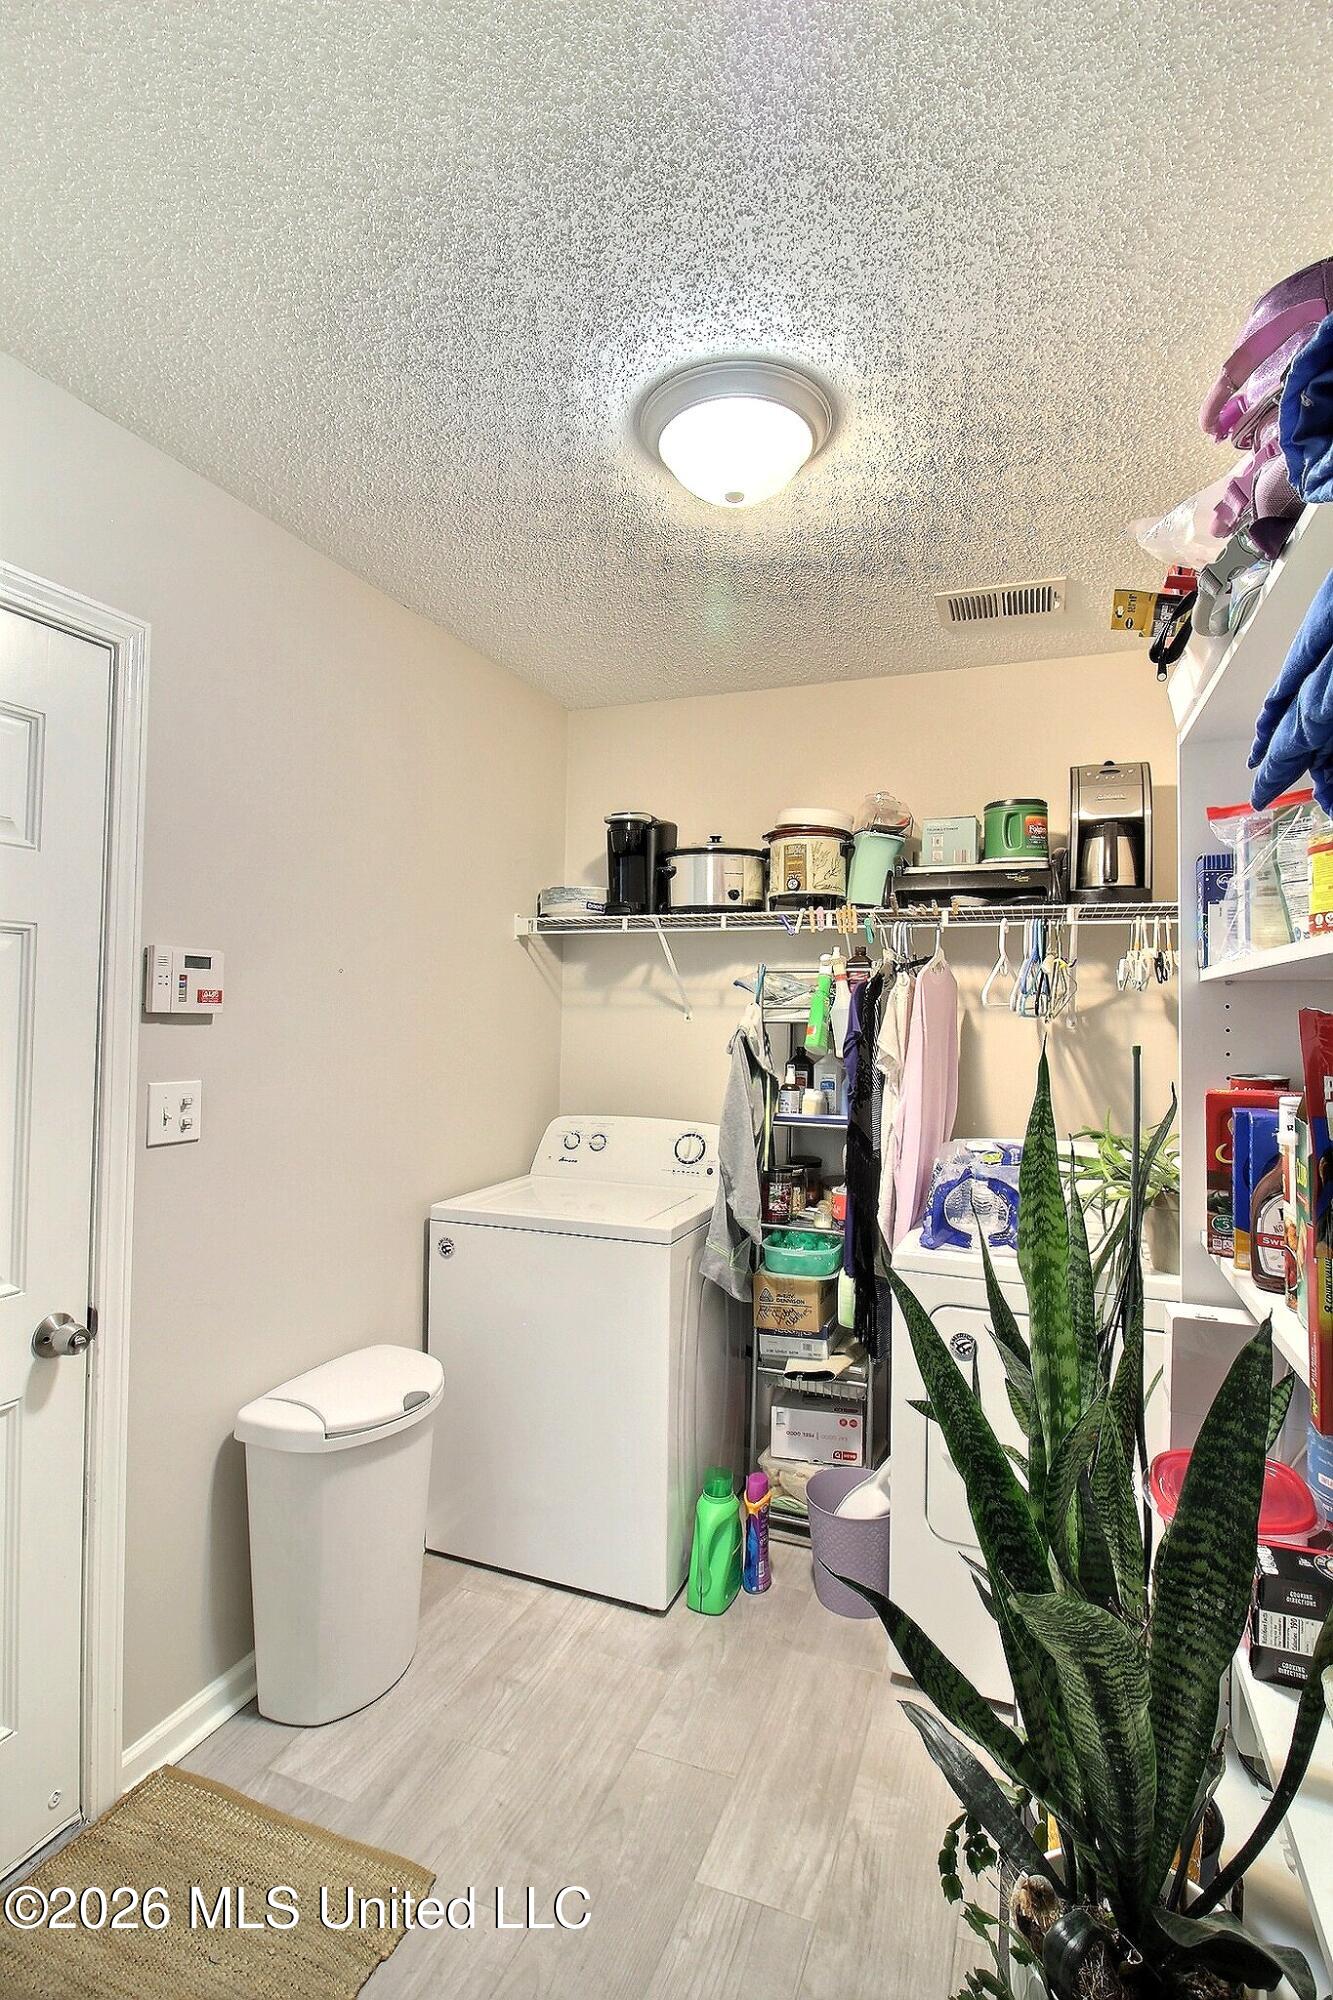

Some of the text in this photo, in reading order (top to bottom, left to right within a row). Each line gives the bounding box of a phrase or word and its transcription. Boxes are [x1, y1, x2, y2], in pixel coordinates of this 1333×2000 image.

[775, 1297, 806, 1305] DENNISON
[1289, 1590, 1313, 1601] COOKING
[1281, 1662, 1306, 1674] COOKING
